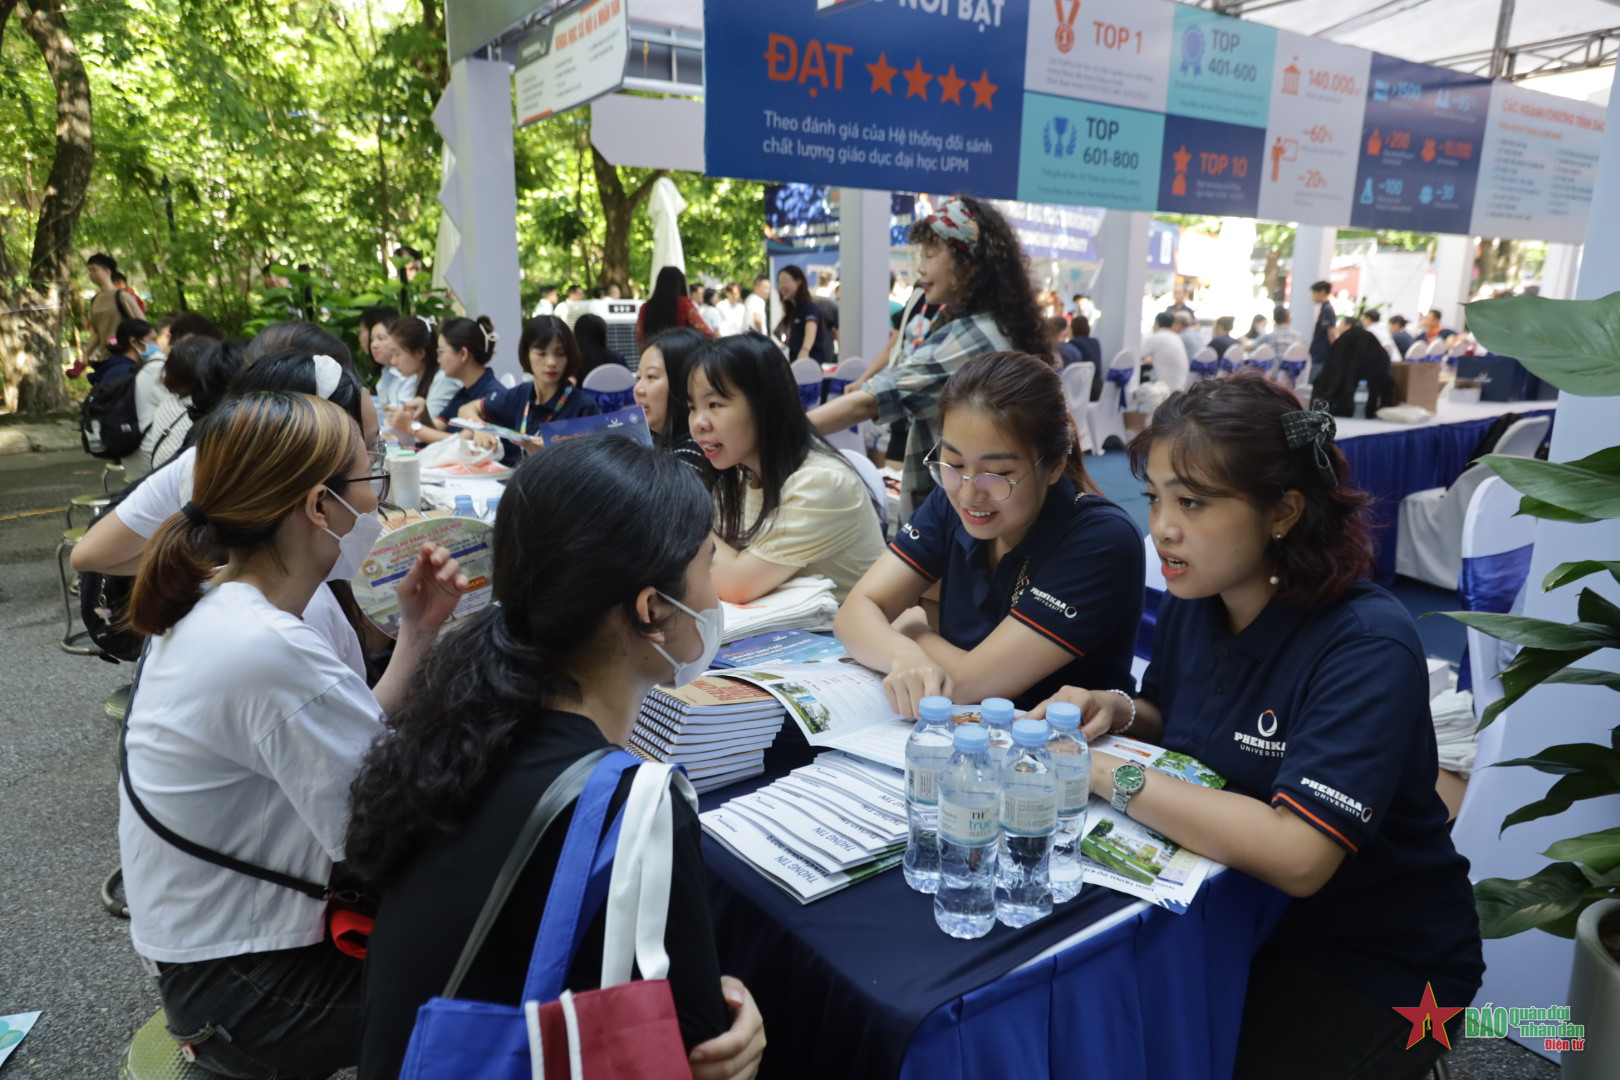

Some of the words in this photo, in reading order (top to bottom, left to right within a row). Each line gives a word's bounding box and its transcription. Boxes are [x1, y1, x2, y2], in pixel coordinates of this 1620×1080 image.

[1093, 21, 1130, 50] TOP
[1135, 31, 1143, 54] 1
[1211, 28, 1240, 53] TOP
[763, 33, 854, 98] ĐẠT
[1207, 57, 1258, 83] 401-600
[763, 110, 798, 131] Theo
[802, 116, 836, 136] đánh
[838, 121, 859, 141] giá
[862, 123, 885, 142] của
[888, 127, 906, 146] Hệ
[908, 130, 943, 152] thống
[966, 138, 993, 154] sánh
[1086, 117, 1119, 141] TOP
[763, 136, 793, 155] chất
[797, 140, 835, 163] lượng
[837, 145, 866, 165] giáo
[869, 148, 892, 167] dục
[894, 151, 914, 169] đại
[917, 153, 938, 171] học
[940, 155, 969, 173] UPM
[1083, 147, 1139, 170] 601-800
[1200, 152, 1229, 175] TOP
[1232, 156, 1249, 178] 10
[1234, 731, 1286, 751] PHENIK
[1240, 744, 1284, 758] UNIVERSIT
[1301, 777, 1363, 812] PHENIKAA
[1314, 790, 1361, 818] UNIVERSITY
[969, 818, 992, 830] true
[774, 855, 790, 867] TIN
